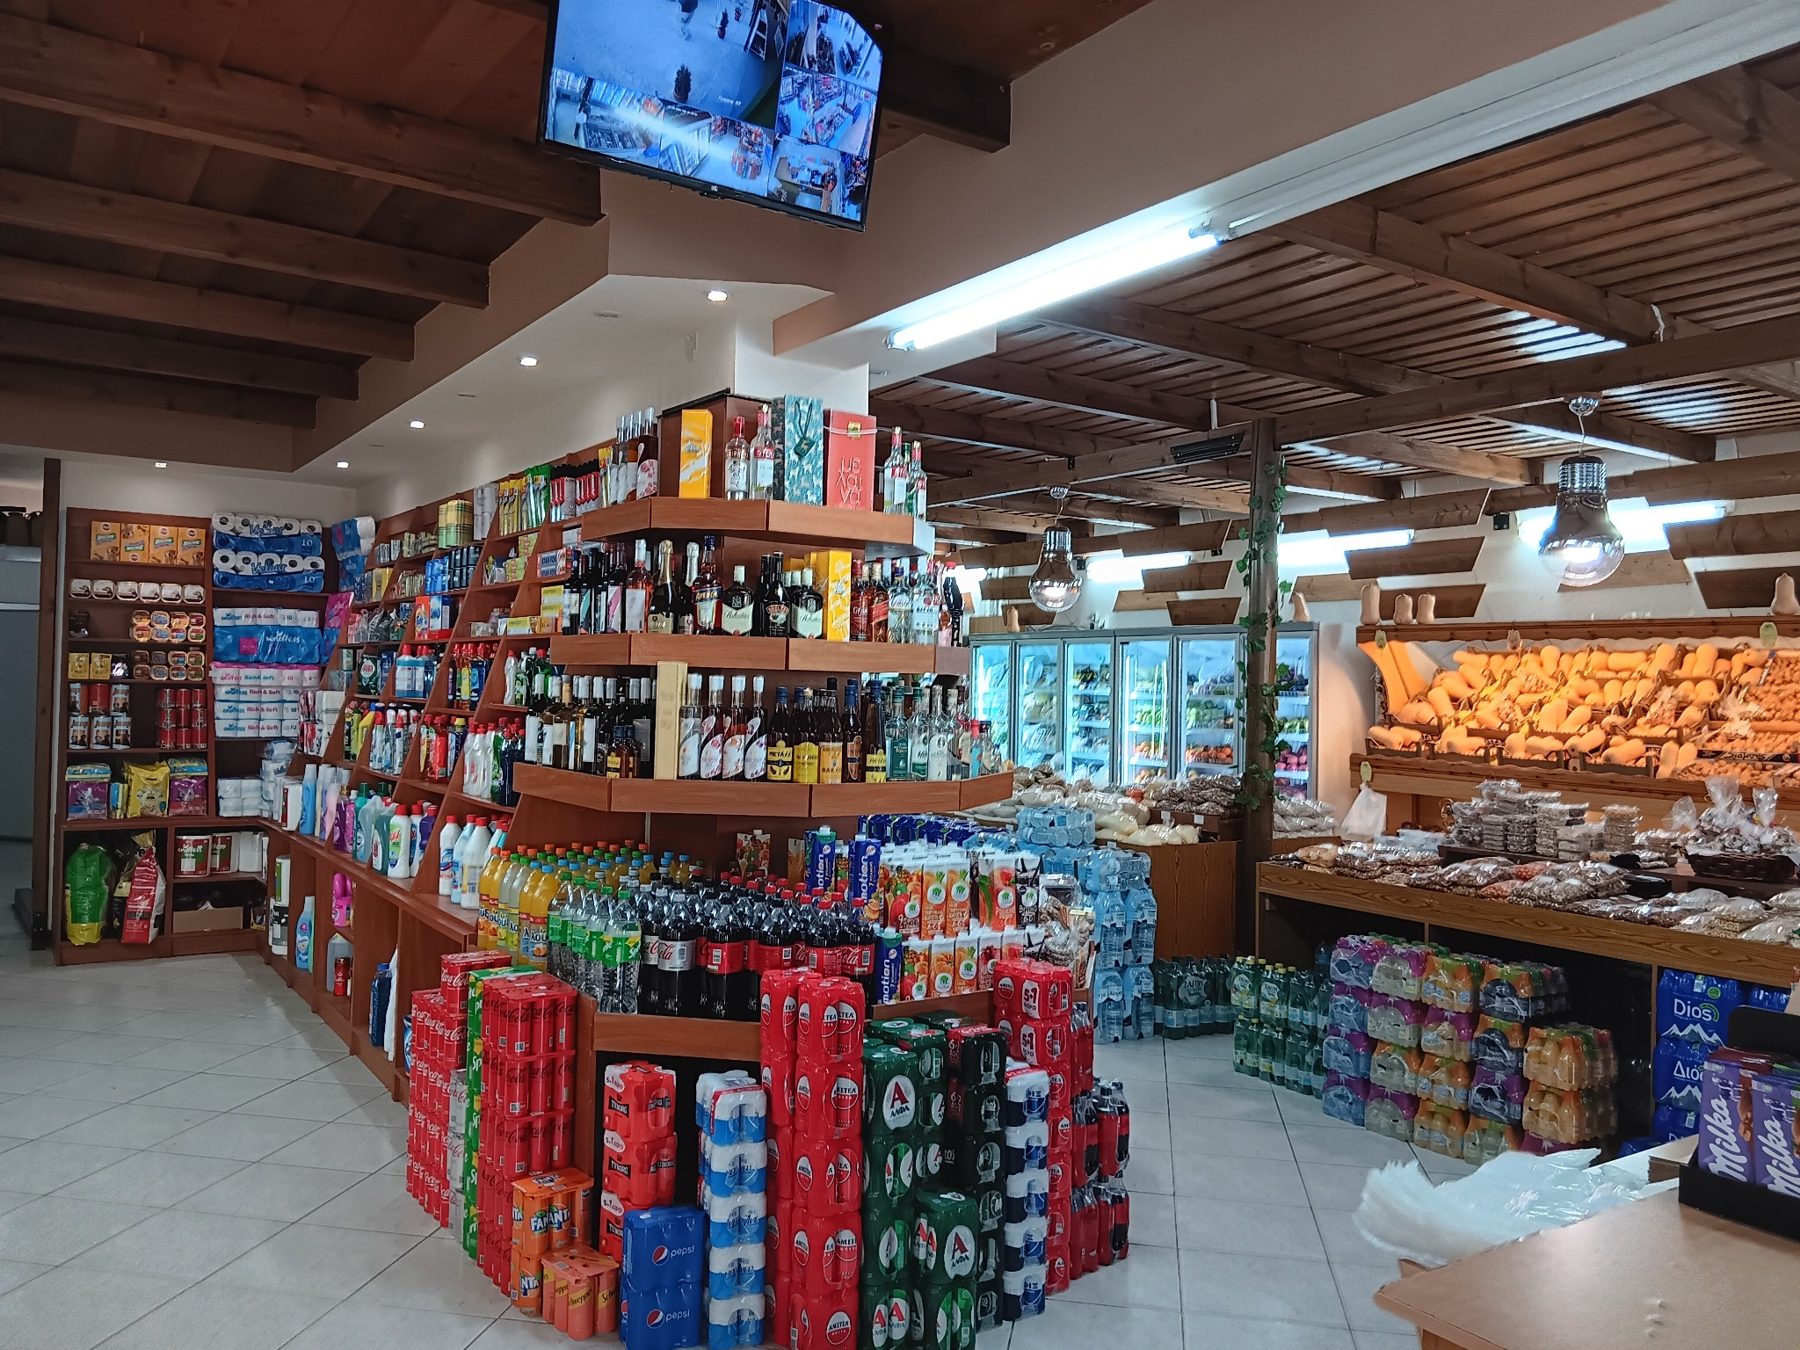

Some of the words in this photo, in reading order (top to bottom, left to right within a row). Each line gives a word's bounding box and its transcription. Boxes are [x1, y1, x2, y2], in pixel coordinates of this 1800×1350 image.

[815, 853, 825, 889] otion
[1023, 987, 1038, 1004] 5+1
[1673, 998, 1713, 1021] Dios
[1703, 1095, 1748, 1182] Milka
[1757, 1116, 1800, 1200] Milka
[549, 1208, 570, 1225] ANT
[670, 1244, 695, 1259] pepsi
[520, 1276, 540, 1290] NTA
[665, 1309, 690, 1322] pepsi
